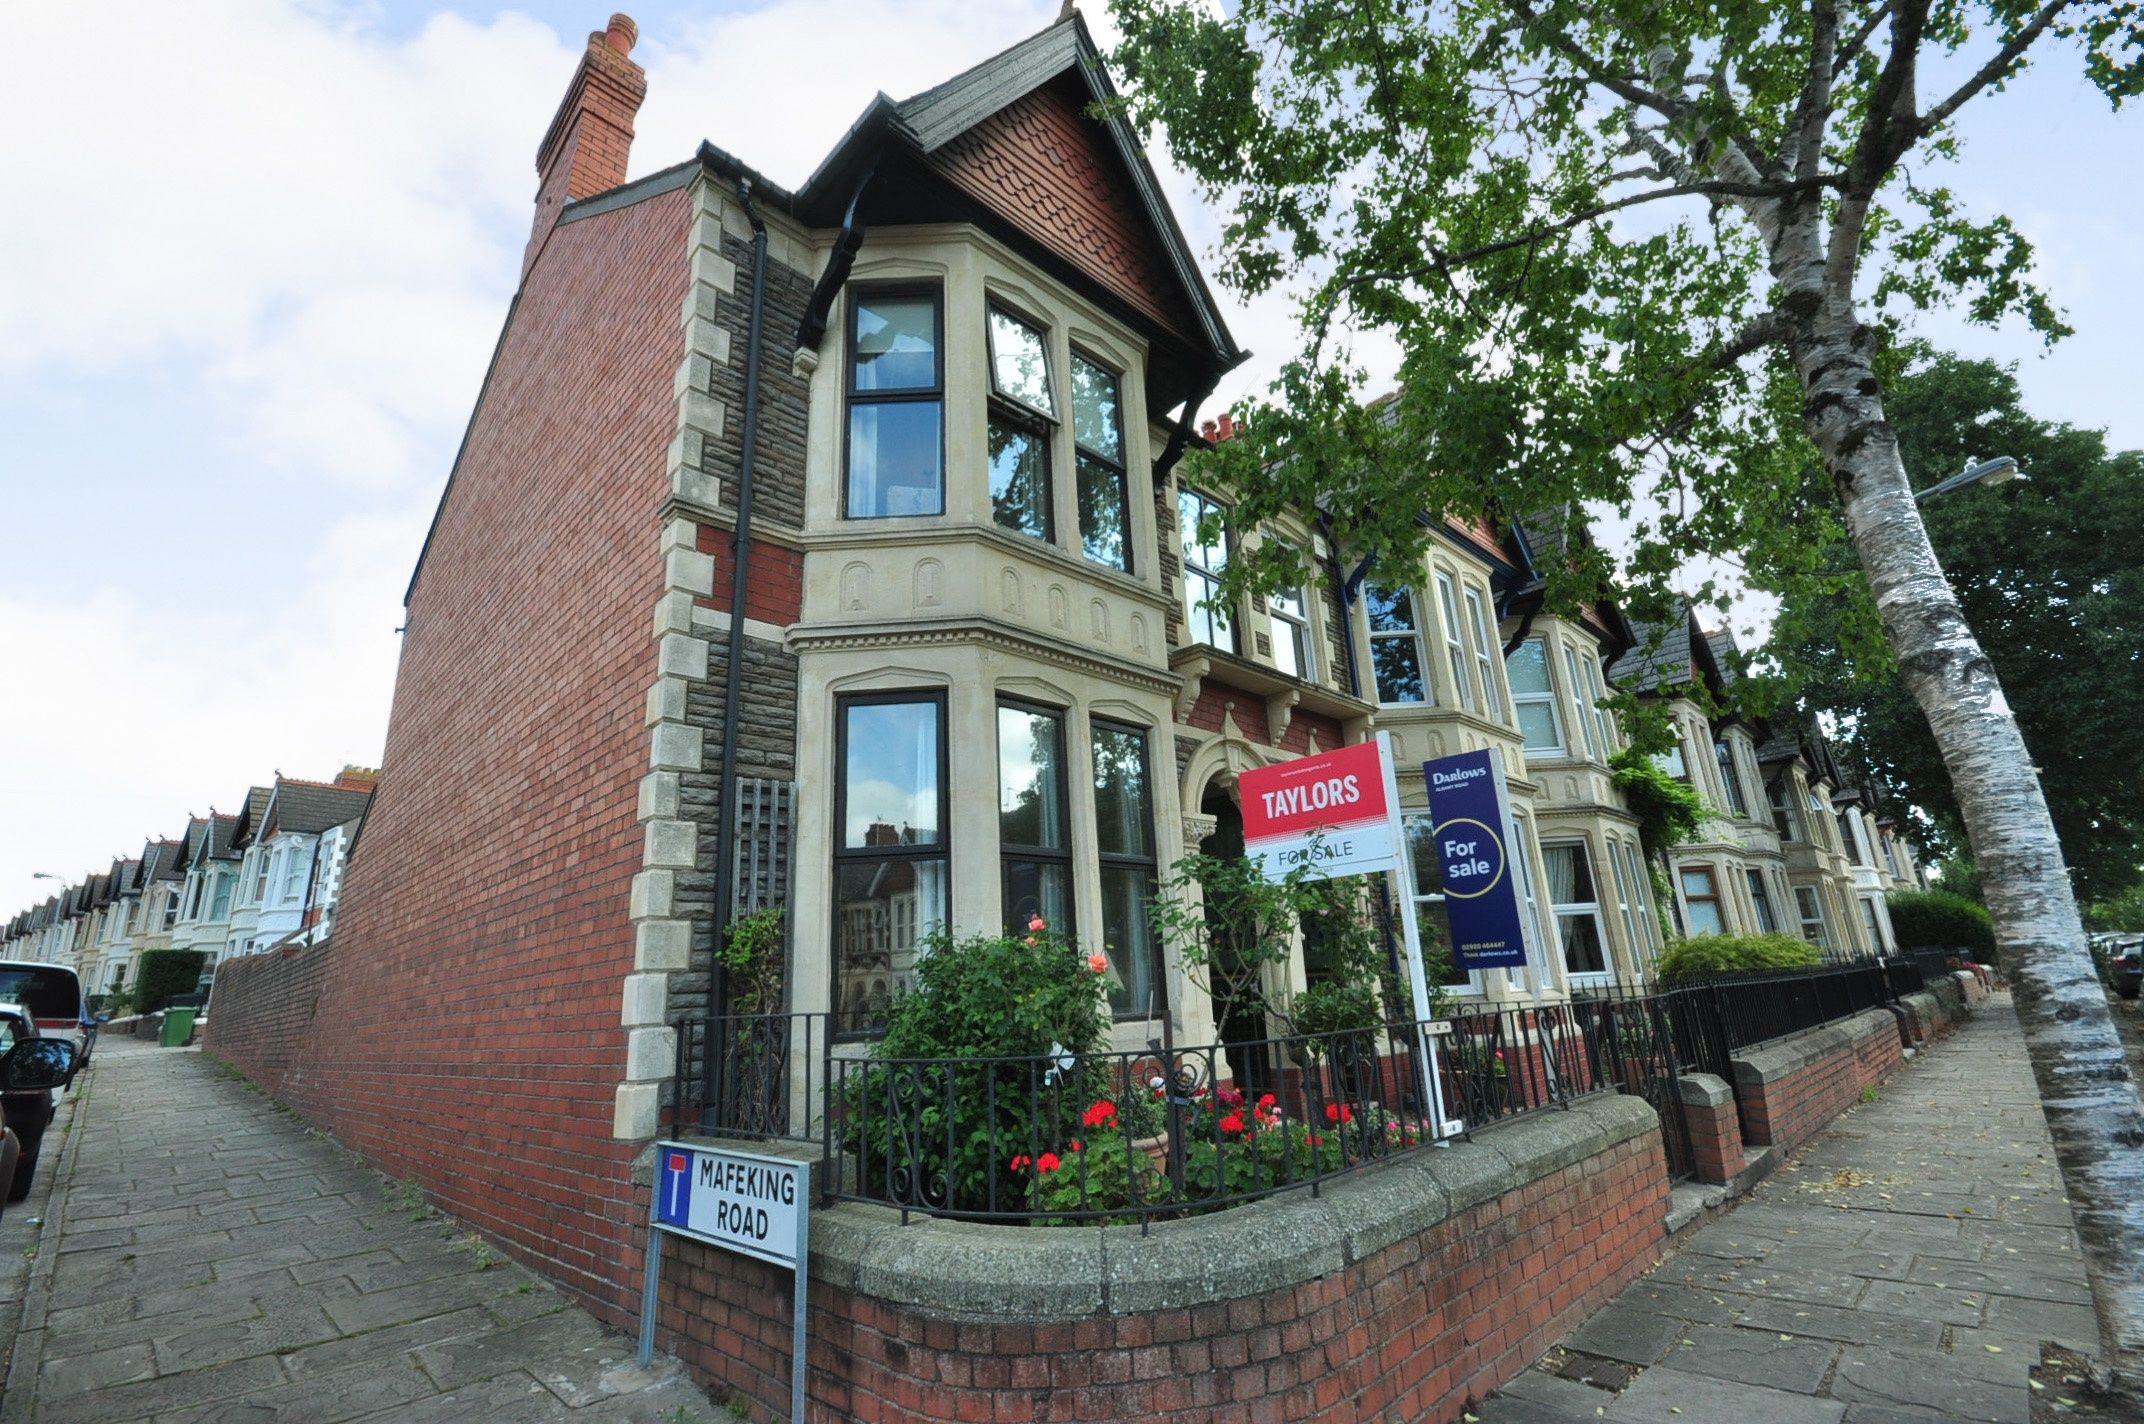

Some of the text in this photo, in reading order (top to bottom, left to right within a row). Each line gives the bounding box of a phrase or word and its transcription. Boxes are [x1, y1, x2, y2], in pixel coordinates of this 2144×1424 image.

[1262, 775, 1360, 819] TAYLORS
[1314, 841, 1353, 860] SALE
[1444, 840, 1477, 858] For
[1449, 859, 1490, 878] sale
[700, 1158, 794, 1205] MAFEKING
[717, 1199, 768, 1240] ROAD
